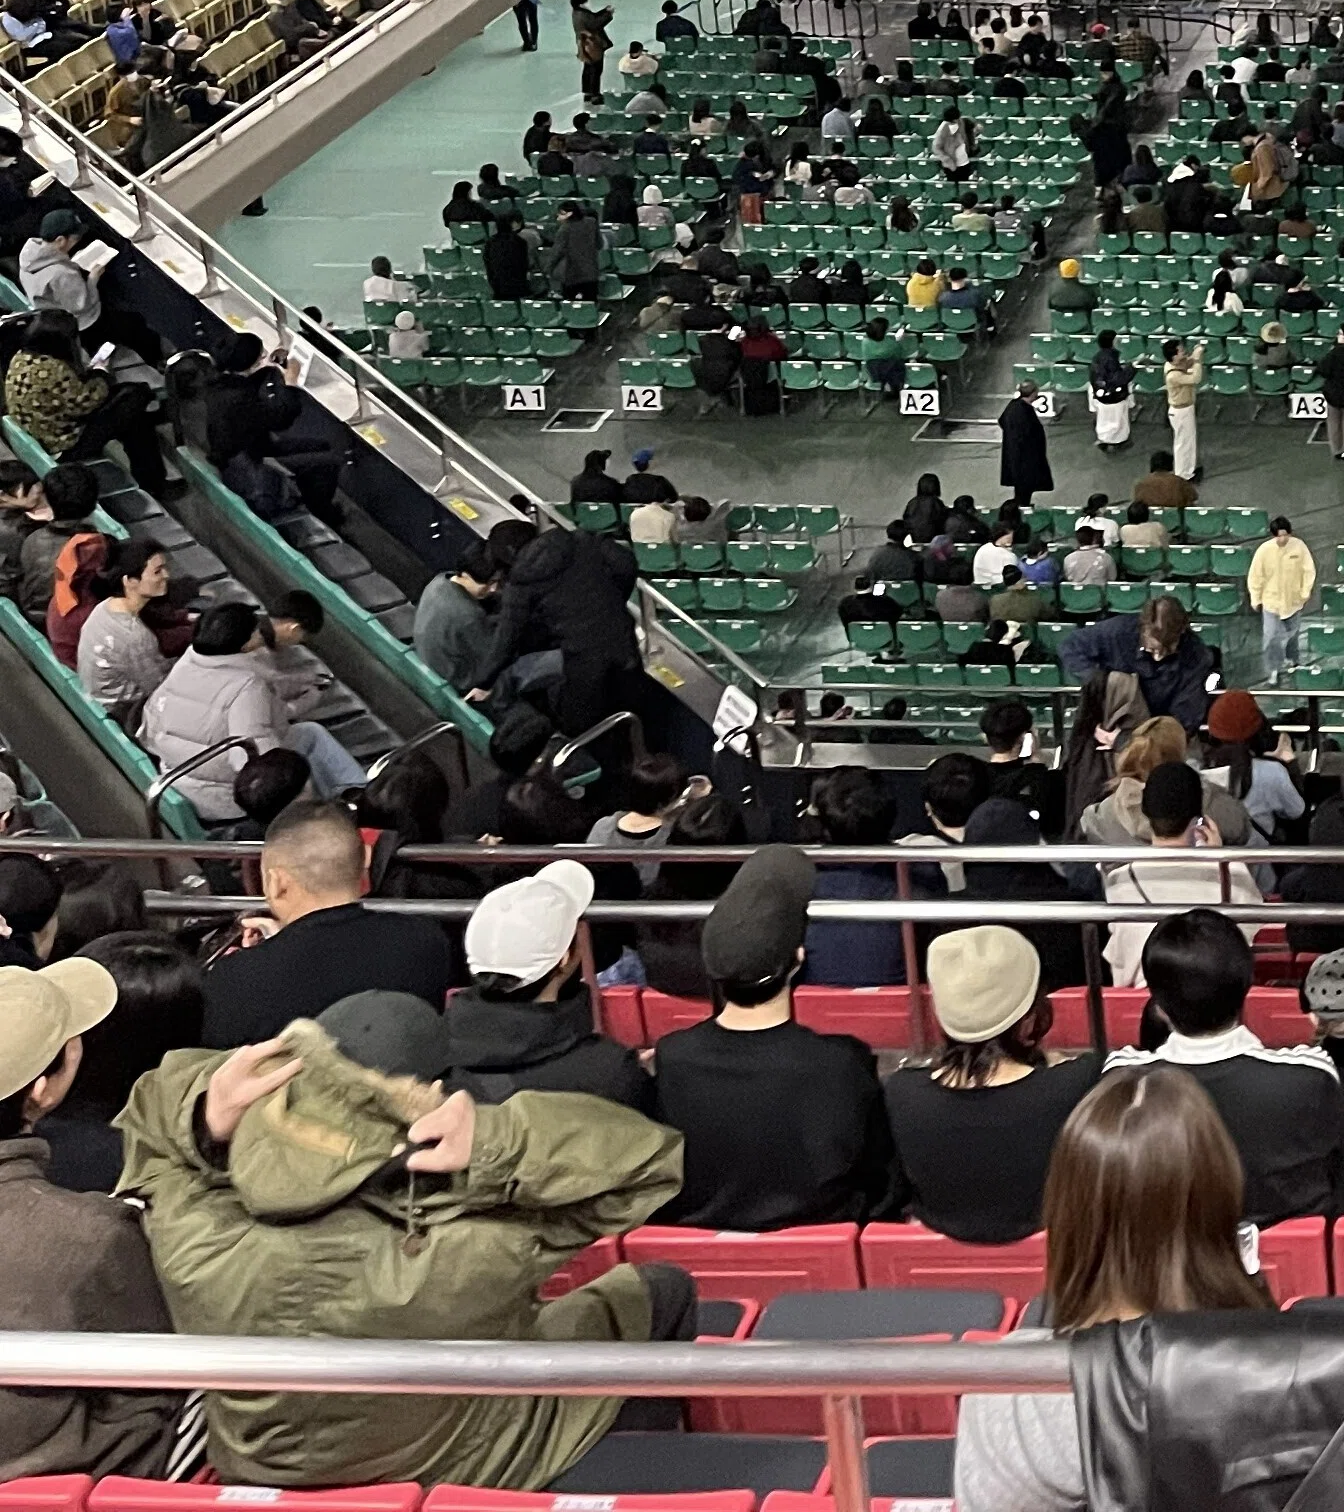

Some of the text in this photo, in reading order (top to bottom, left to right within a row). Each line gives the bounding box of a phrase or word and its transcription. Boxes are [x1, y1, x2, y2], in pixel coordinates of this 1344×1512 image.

[510, 388, 542, 408] A1
[626, 389, 657, 408] A2
[905, 393, 935, 412] A2
[1296, 396, 1326, 415] A3
